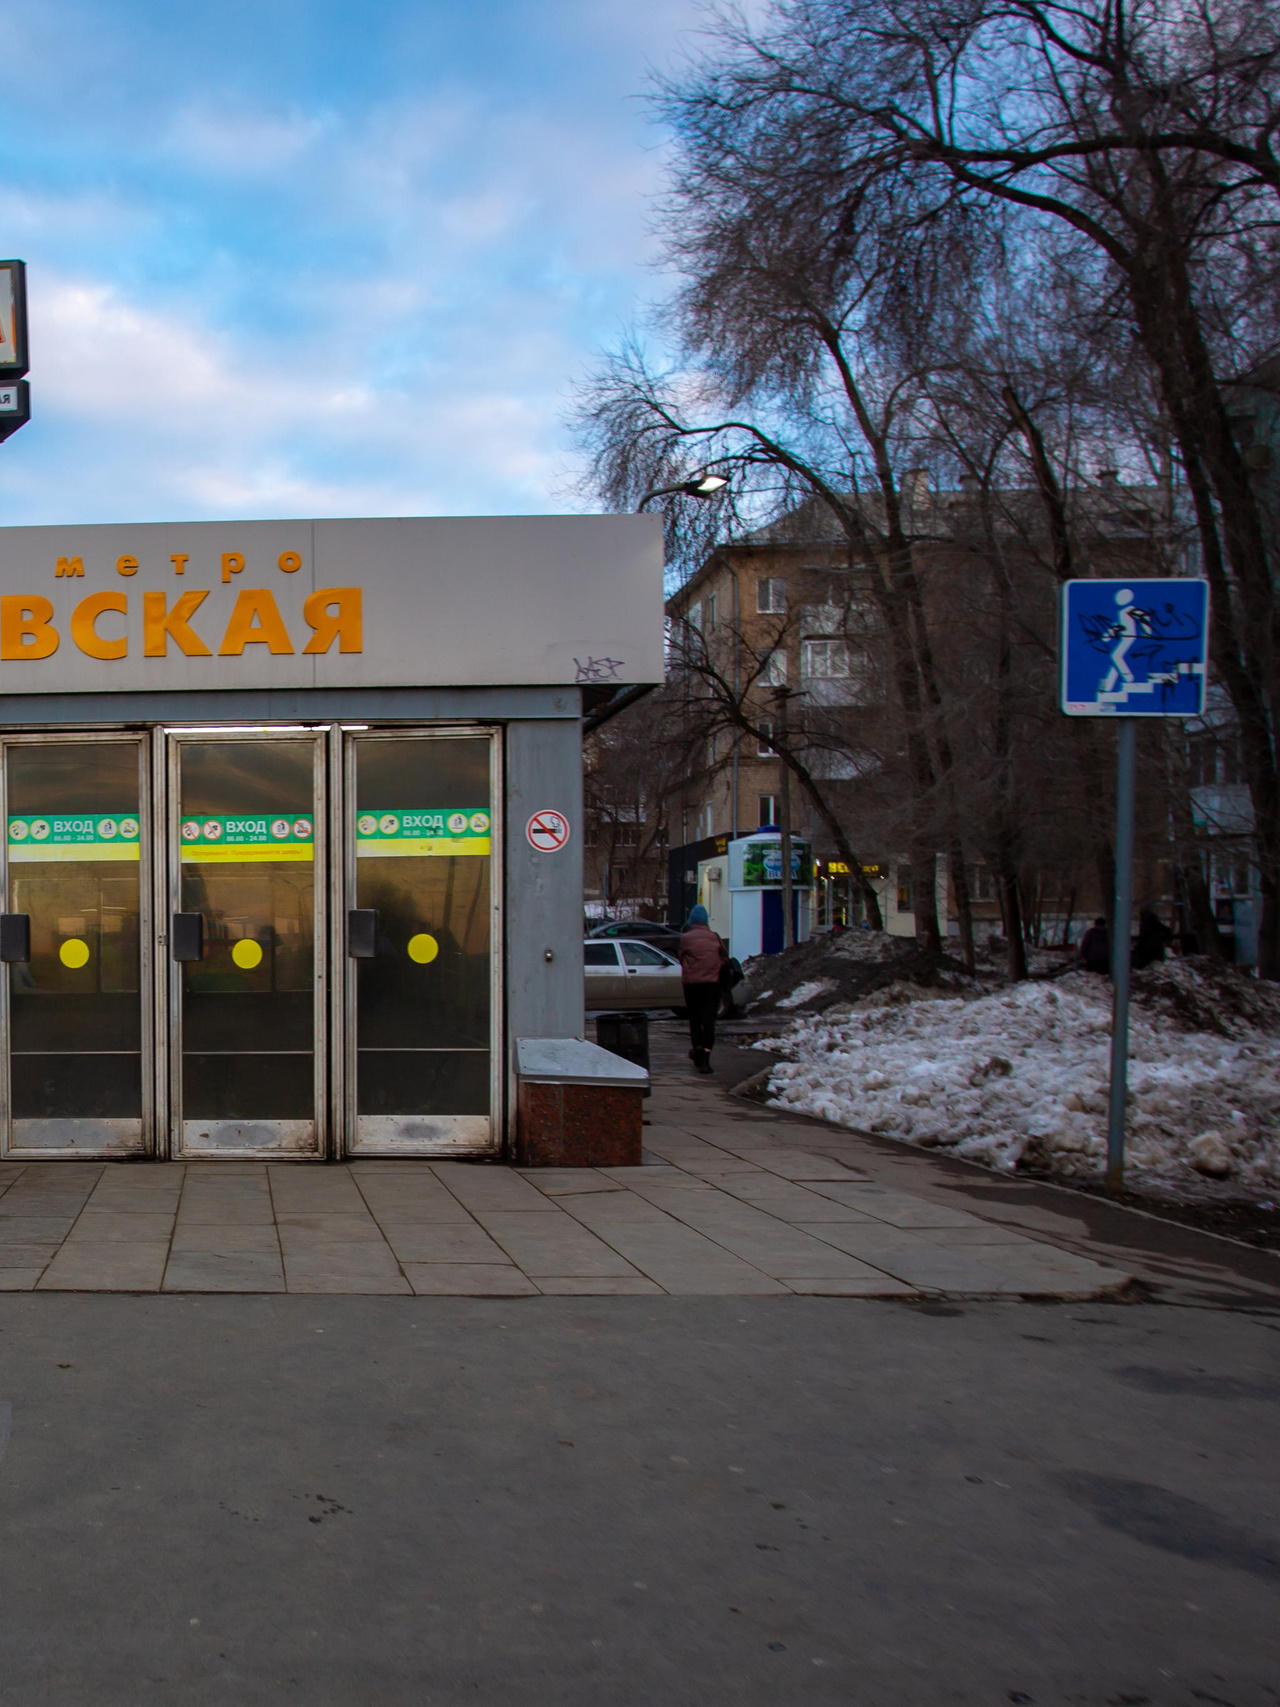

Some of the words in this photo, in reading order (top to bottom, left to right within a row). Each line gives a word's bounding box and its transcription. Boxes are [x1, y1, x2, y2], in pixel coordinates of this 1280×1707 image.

[54, 551, 303, 583] метро
[54, 820, 94, 834] ВХОД
[226, 820, 267, 834] ВХОД
[402, 816, 444, 828] ВХОД
